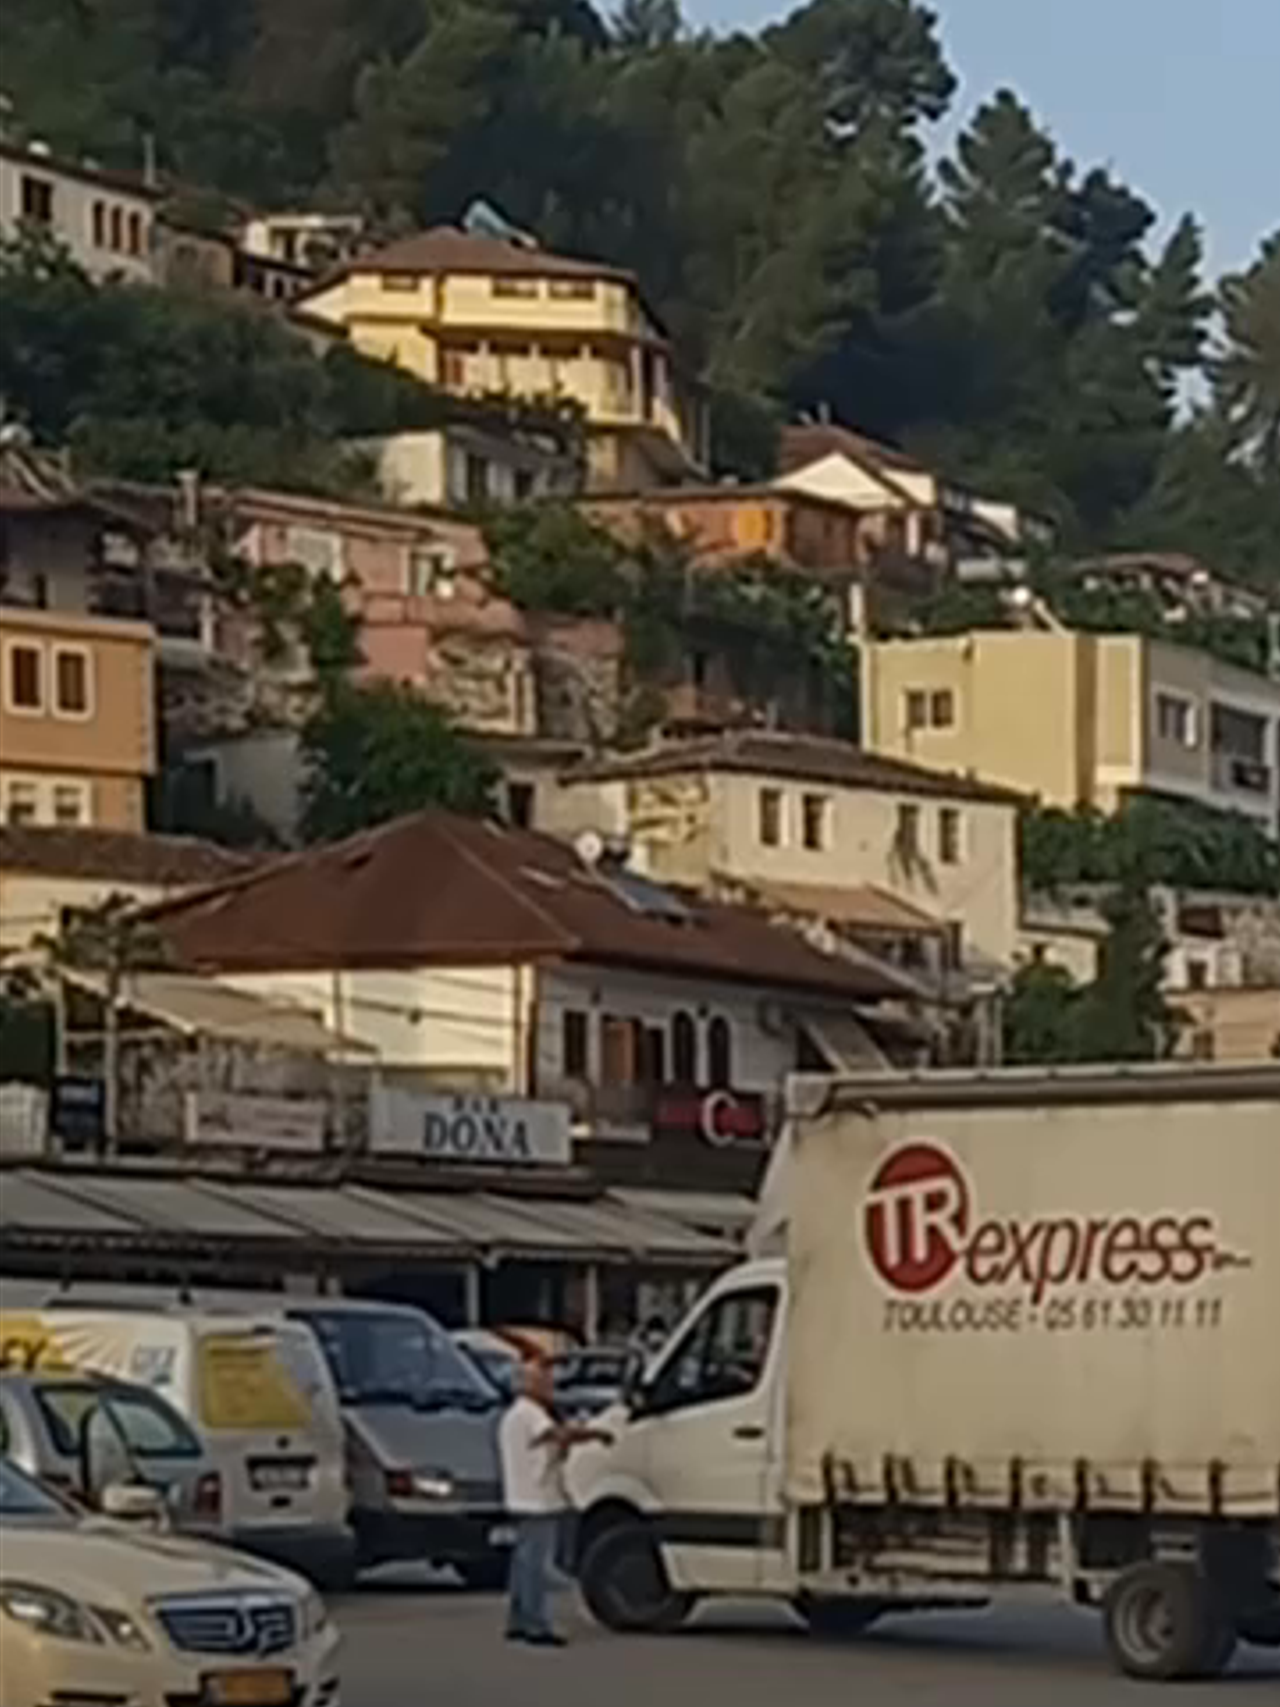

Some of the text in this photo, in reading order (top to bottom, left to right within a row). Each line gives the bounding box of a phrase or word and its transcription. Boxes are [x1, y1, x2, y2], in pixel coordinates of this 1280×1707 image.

[424, 1112, 531, 1156] DONA
[882, 1298, 1022, 1333] TOULOUSE
[1044, 1298, 1075, 1331] 05
